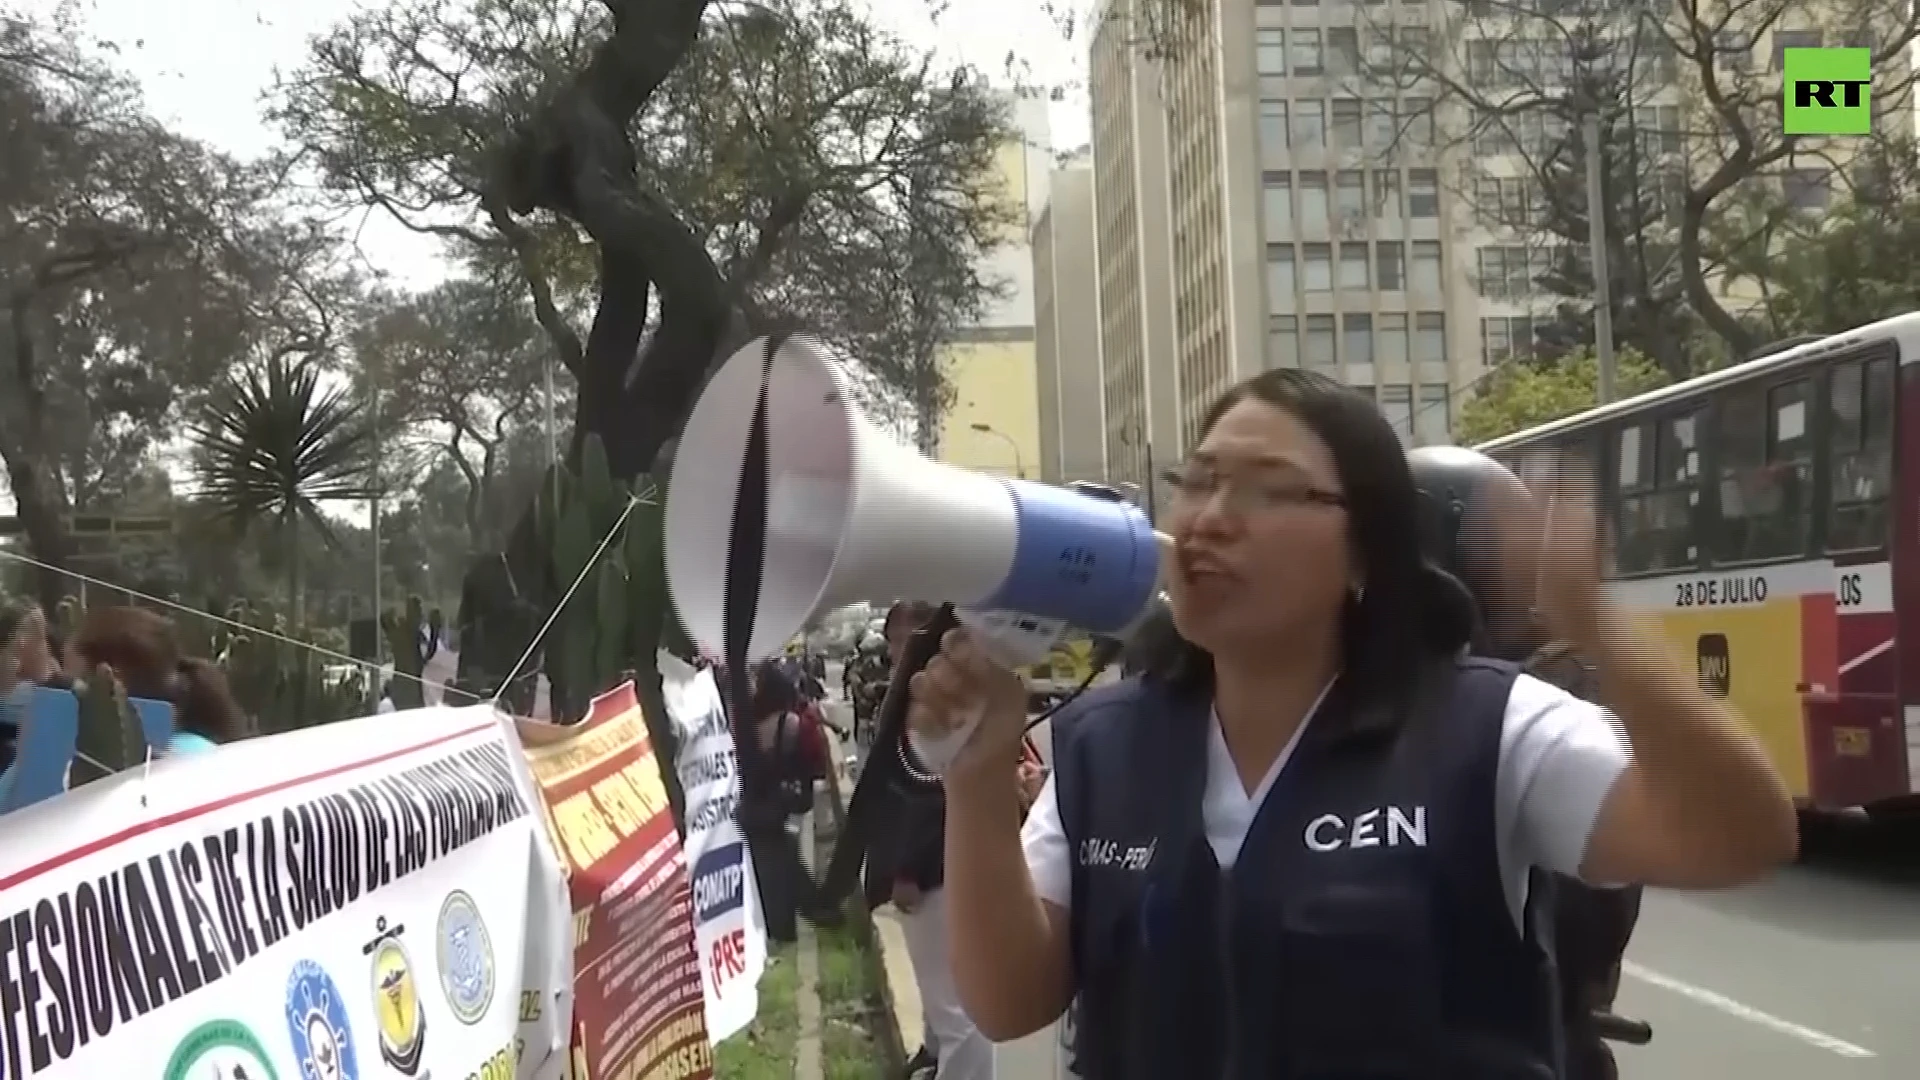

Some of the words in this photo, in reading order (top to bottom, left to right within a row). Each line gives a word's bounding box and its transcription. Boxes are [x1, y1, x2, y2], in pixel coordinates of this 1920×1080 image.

[1676, 583, 1694, 607] 28
[1697, 580, 1717, 605] DE
[1720, 576, 1768, 603] JULIO
[1836, 573, 1862, 606] OS
[1304, 805, 1428, 852] CEN
[693, 863, 745, 913] CONATP
[0, 841, 231, 1080] FESIONALES
[203, 827, 259, 966] DE
[246, 816, 289, 947] LA
[283, 793, 360, 932] SALUD
[347, 784, 390, 893] DE
[371, 774, 427, 879] LAS
